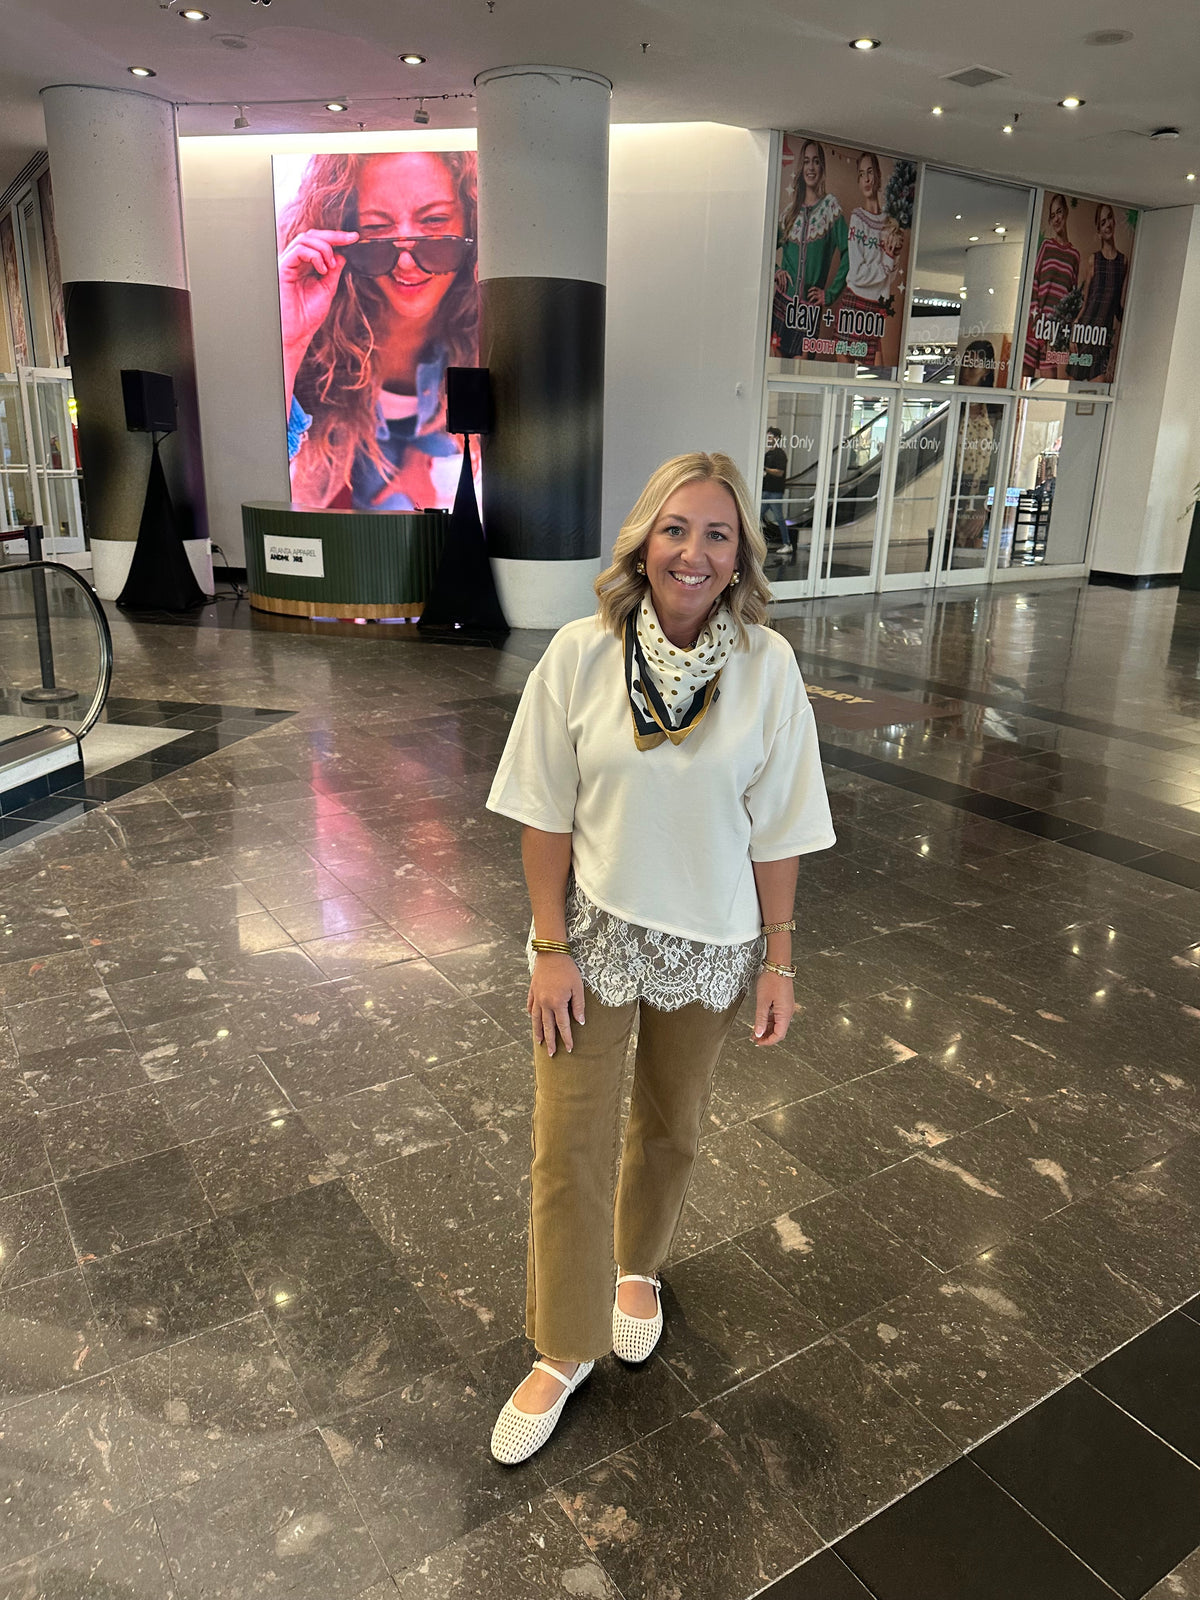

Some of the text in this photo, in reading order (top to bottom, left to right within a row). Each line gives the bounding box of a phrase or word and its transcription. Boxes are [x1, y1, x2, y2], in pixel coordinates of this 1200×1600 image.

[786, 295, 820, 337] day
[838, 308, 886, 337] moon
[1035, 313, 1060, 346] day
[1072, 323, 1107, 346] moon
[803, 338, 835, 354] BOOTH
[963, 355, 1006, 370] Escalators
[766, 434, 815, 452] Exit Only
[899, 436, 941, 453] Exit Only
[963, 438, 1000, 454] Exit Only
[293, 549, 316, 557] APPAREL
